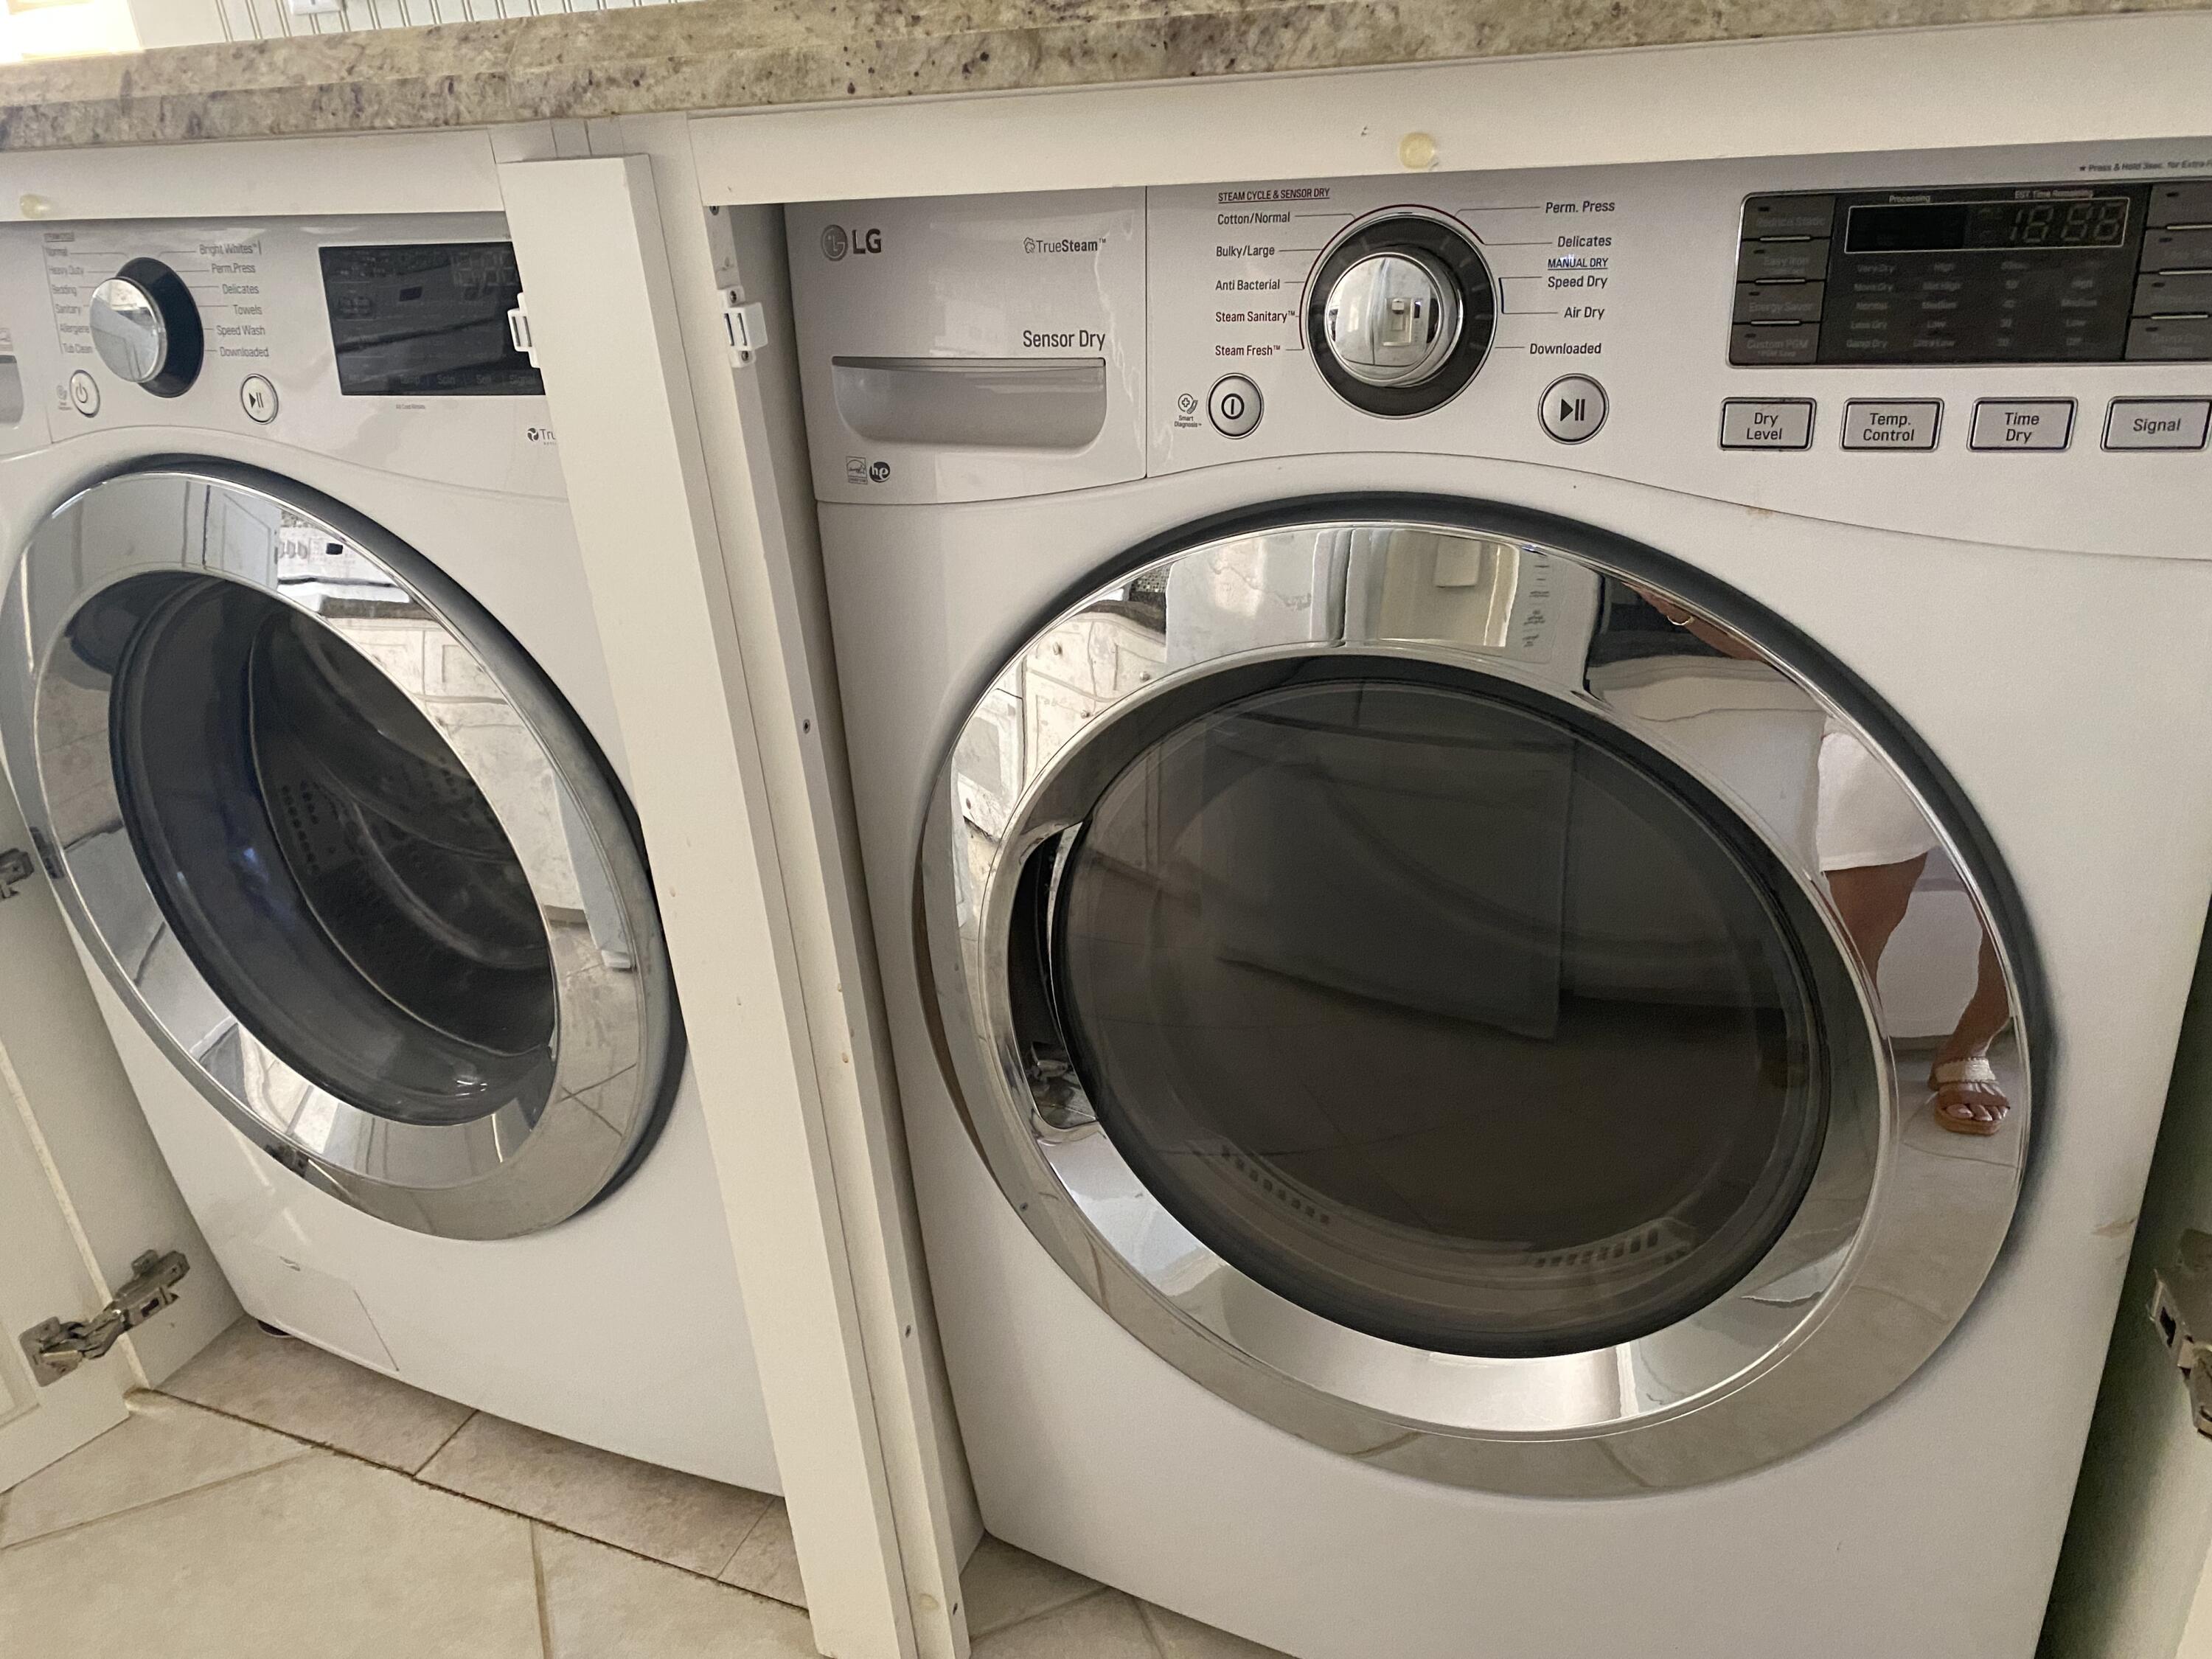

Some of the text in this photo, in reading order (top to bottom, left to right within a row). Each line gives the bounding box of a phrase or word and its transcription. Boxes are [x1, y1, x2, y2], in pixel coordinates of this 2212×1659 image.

[1218, 188, 1330, 202] STEAM CYCLE & SENSOR DRY
[1889, 195, 1931, 203] Processing
[1545, 201, 1615, 213] Perm. Press
[1217, 212, 1290, 225] Cotton/Normal
[852, 229, 881, 254] LG
[1557, 235, 1612, 247] Delicates
[1216, 246, 1275, 258] Bulky/Large
[1548, 258, 1609, 268] MANUAL DRY
[1215, 279, 1280, 291] Anti Bacterial
[1548, 275, 1608, 290] Speed Dry
[222, 284, 259, 294] Delicates
[233, 305, 262, 315] Towels
[1564, 307, 1605, 320] Air Dry
[1216, 311, 1245, 322] Steam
[216, 325, 265, 337] Speed Wash
[1023, 330, 1105, 351] Sensor Dry
[220, 347, 269, 358] Downloaded
[1215, 345, 1245, 356] Steam
[1530, 343, 1601, 355] Downloaded
[1754, 412, 1778, 428] Dry
[1869, 413, 1911, 428] Temp.
[2004, 412, 2039, 425] Time
[2132, 418, 2181, 435] Signal
[1747, 428, 1782, 441] Level
[1863, 428, 1915, 442] Control
[2006, 428, 2032, 444] Dry
